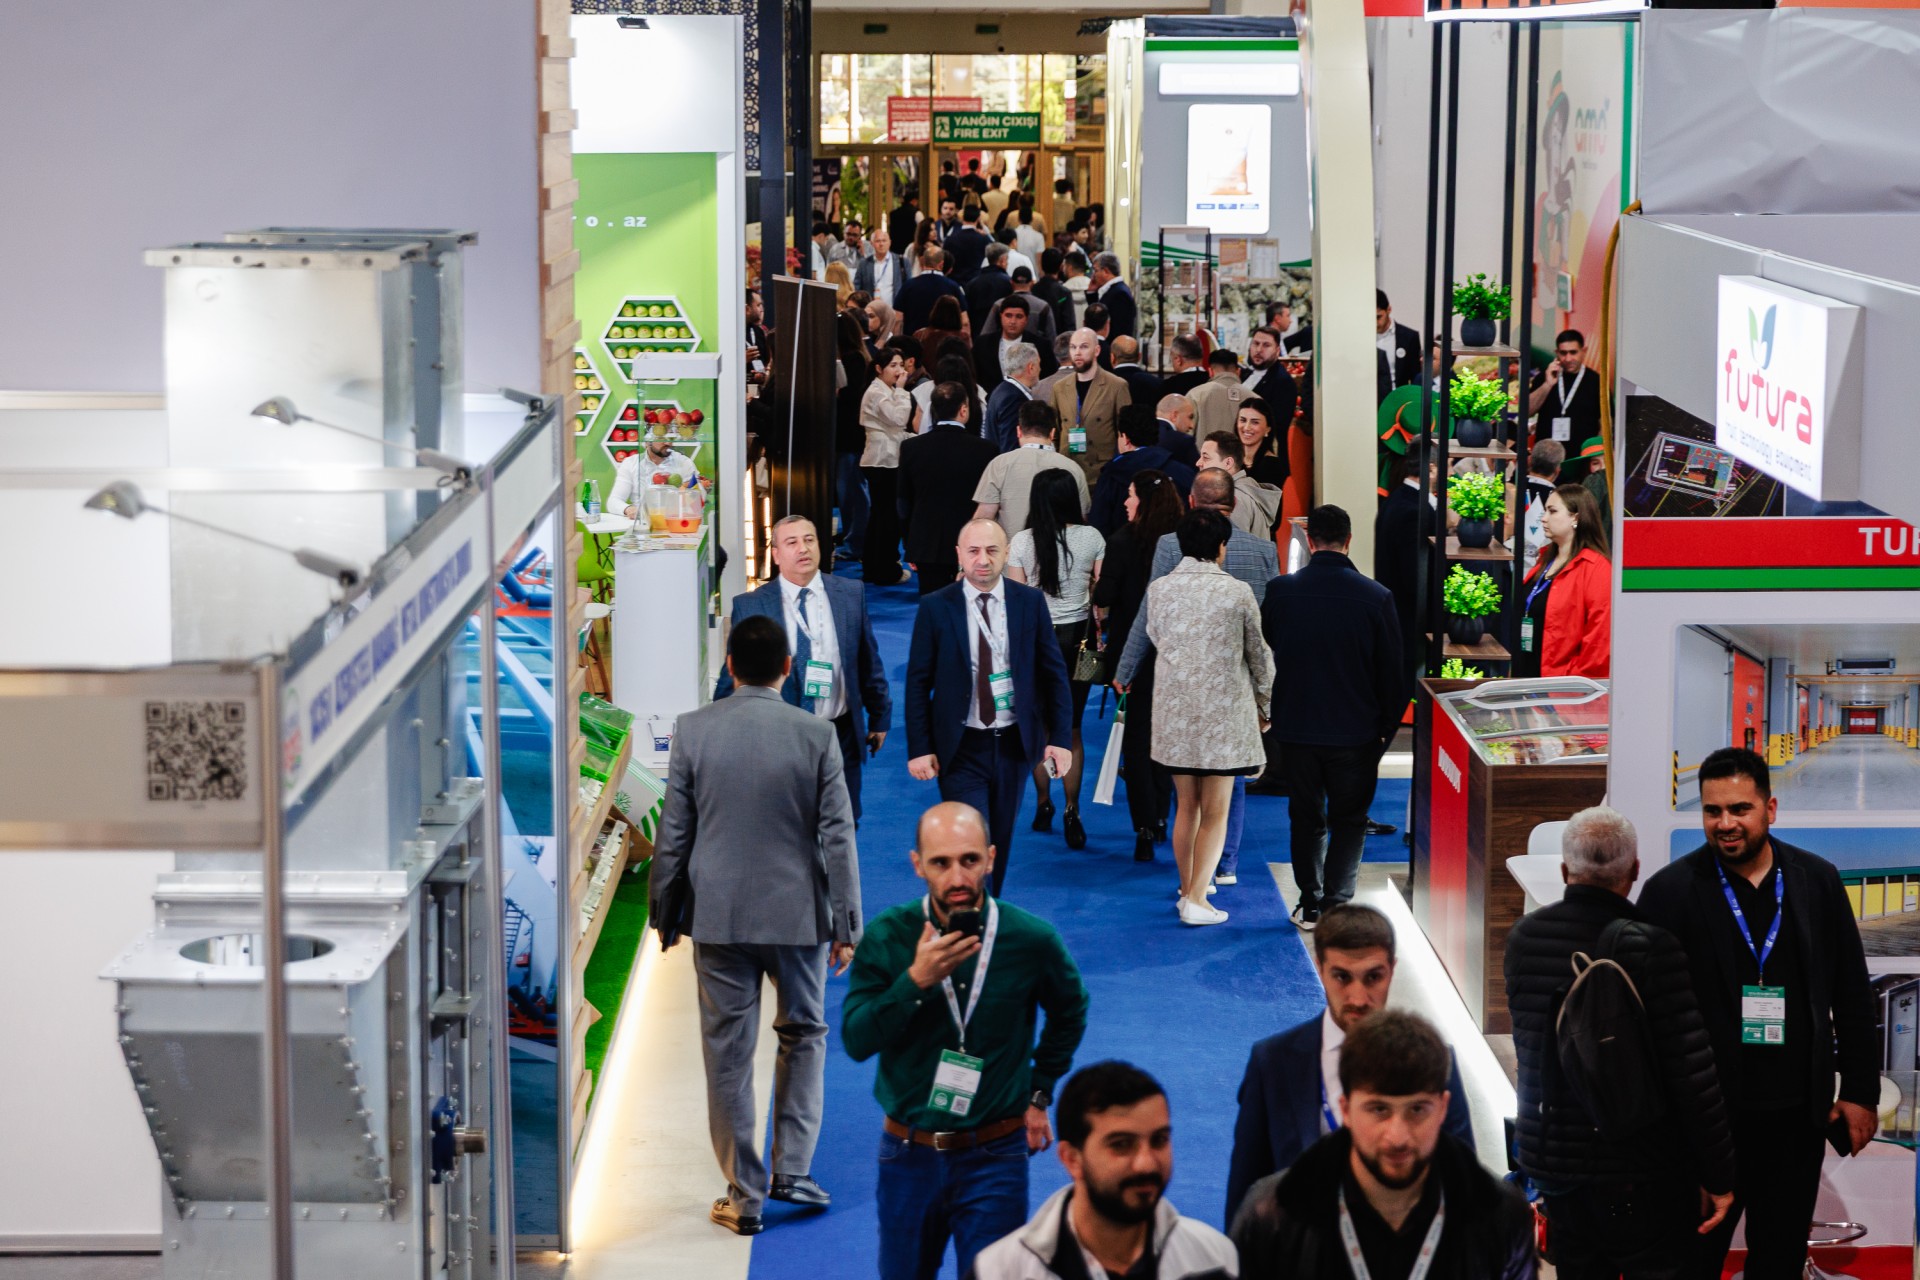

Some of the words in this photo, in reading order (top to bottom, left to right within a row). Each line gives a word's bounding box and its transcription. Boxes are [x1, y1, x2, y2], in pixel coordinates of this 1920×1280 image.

[953, 114, 1000, 126] YANĞIN
[953, 128, 980, 139] FIRE
[982, 128, 1010, 139] EXIT
[1725, 348, 1812, 445] futura
